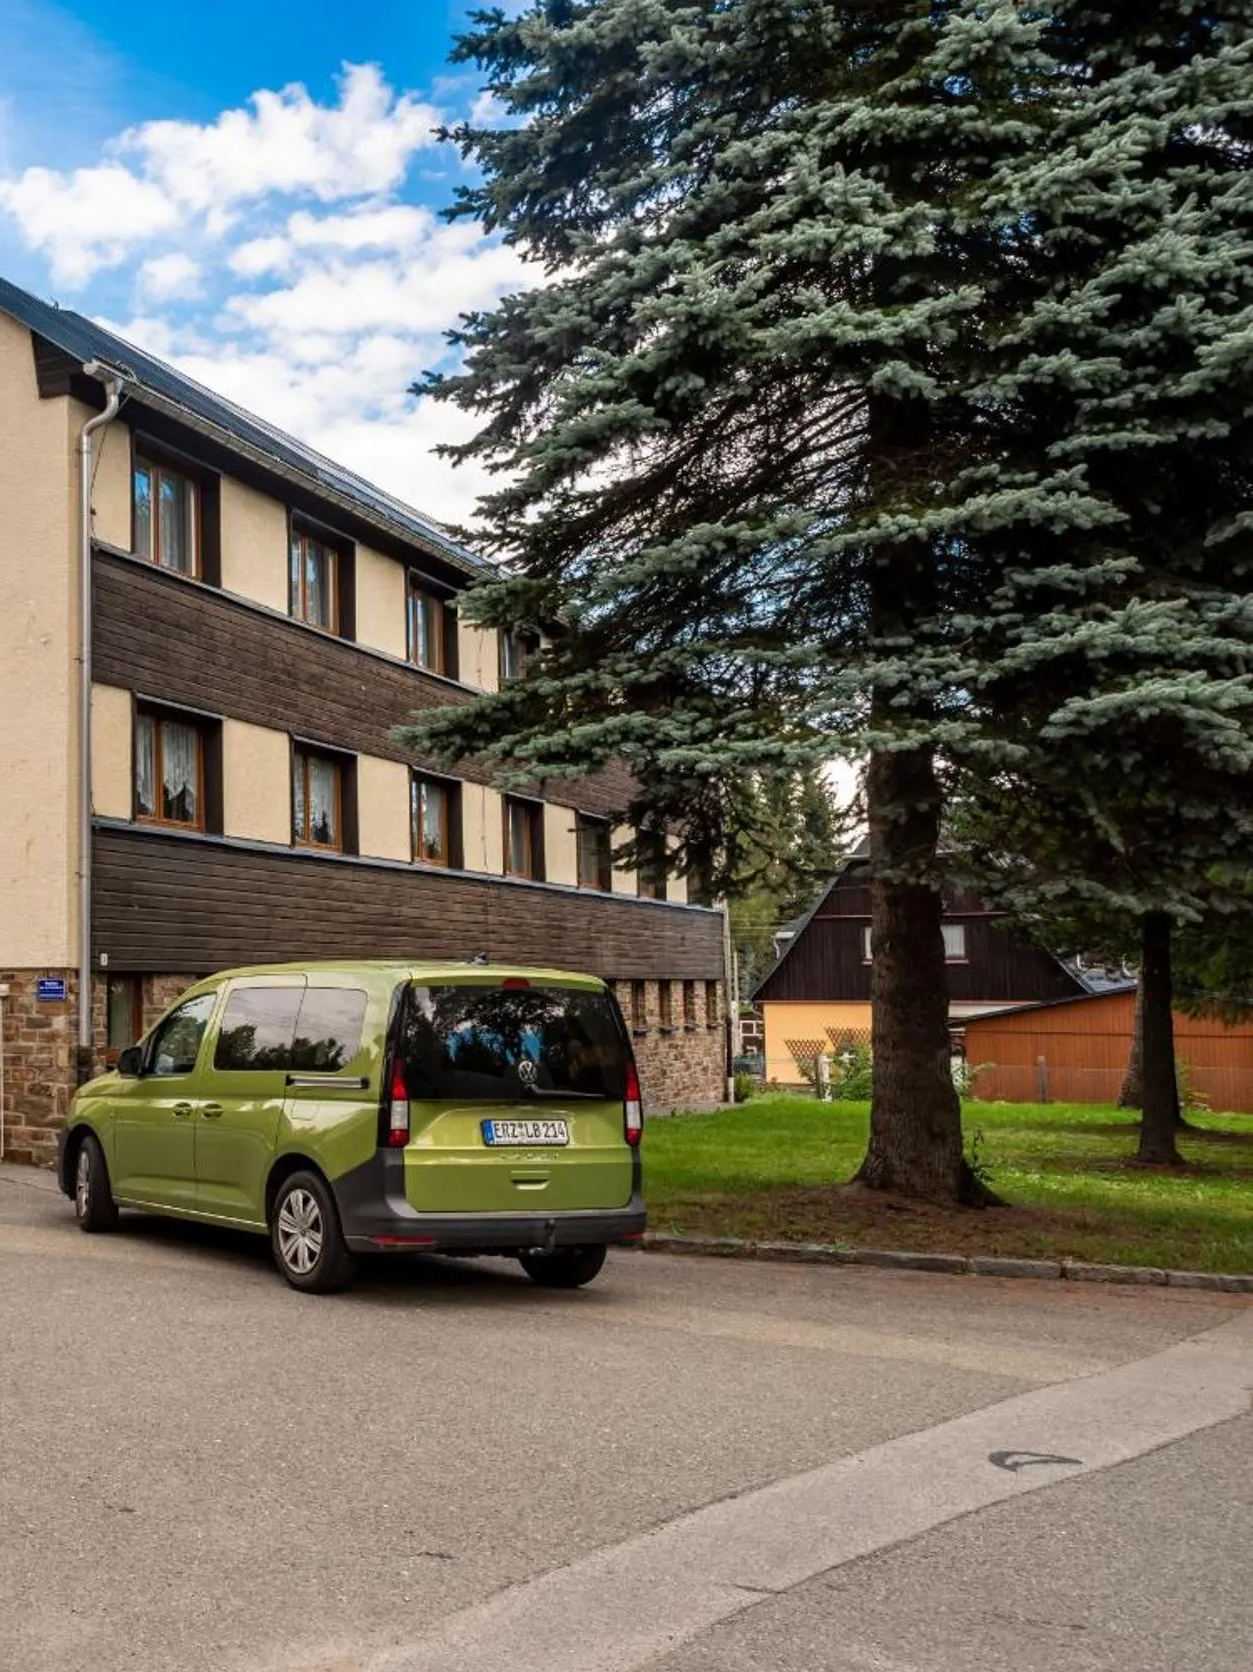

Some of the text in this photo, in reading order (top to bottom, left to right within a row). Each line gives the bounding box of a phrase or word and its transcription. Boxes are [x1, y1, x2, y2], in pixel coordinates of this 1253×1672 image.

[494, 1122, 518, 1138] ERZ
[525, 1122, 541, 1138] LB
[544, 1122, 565, 1138] 214
